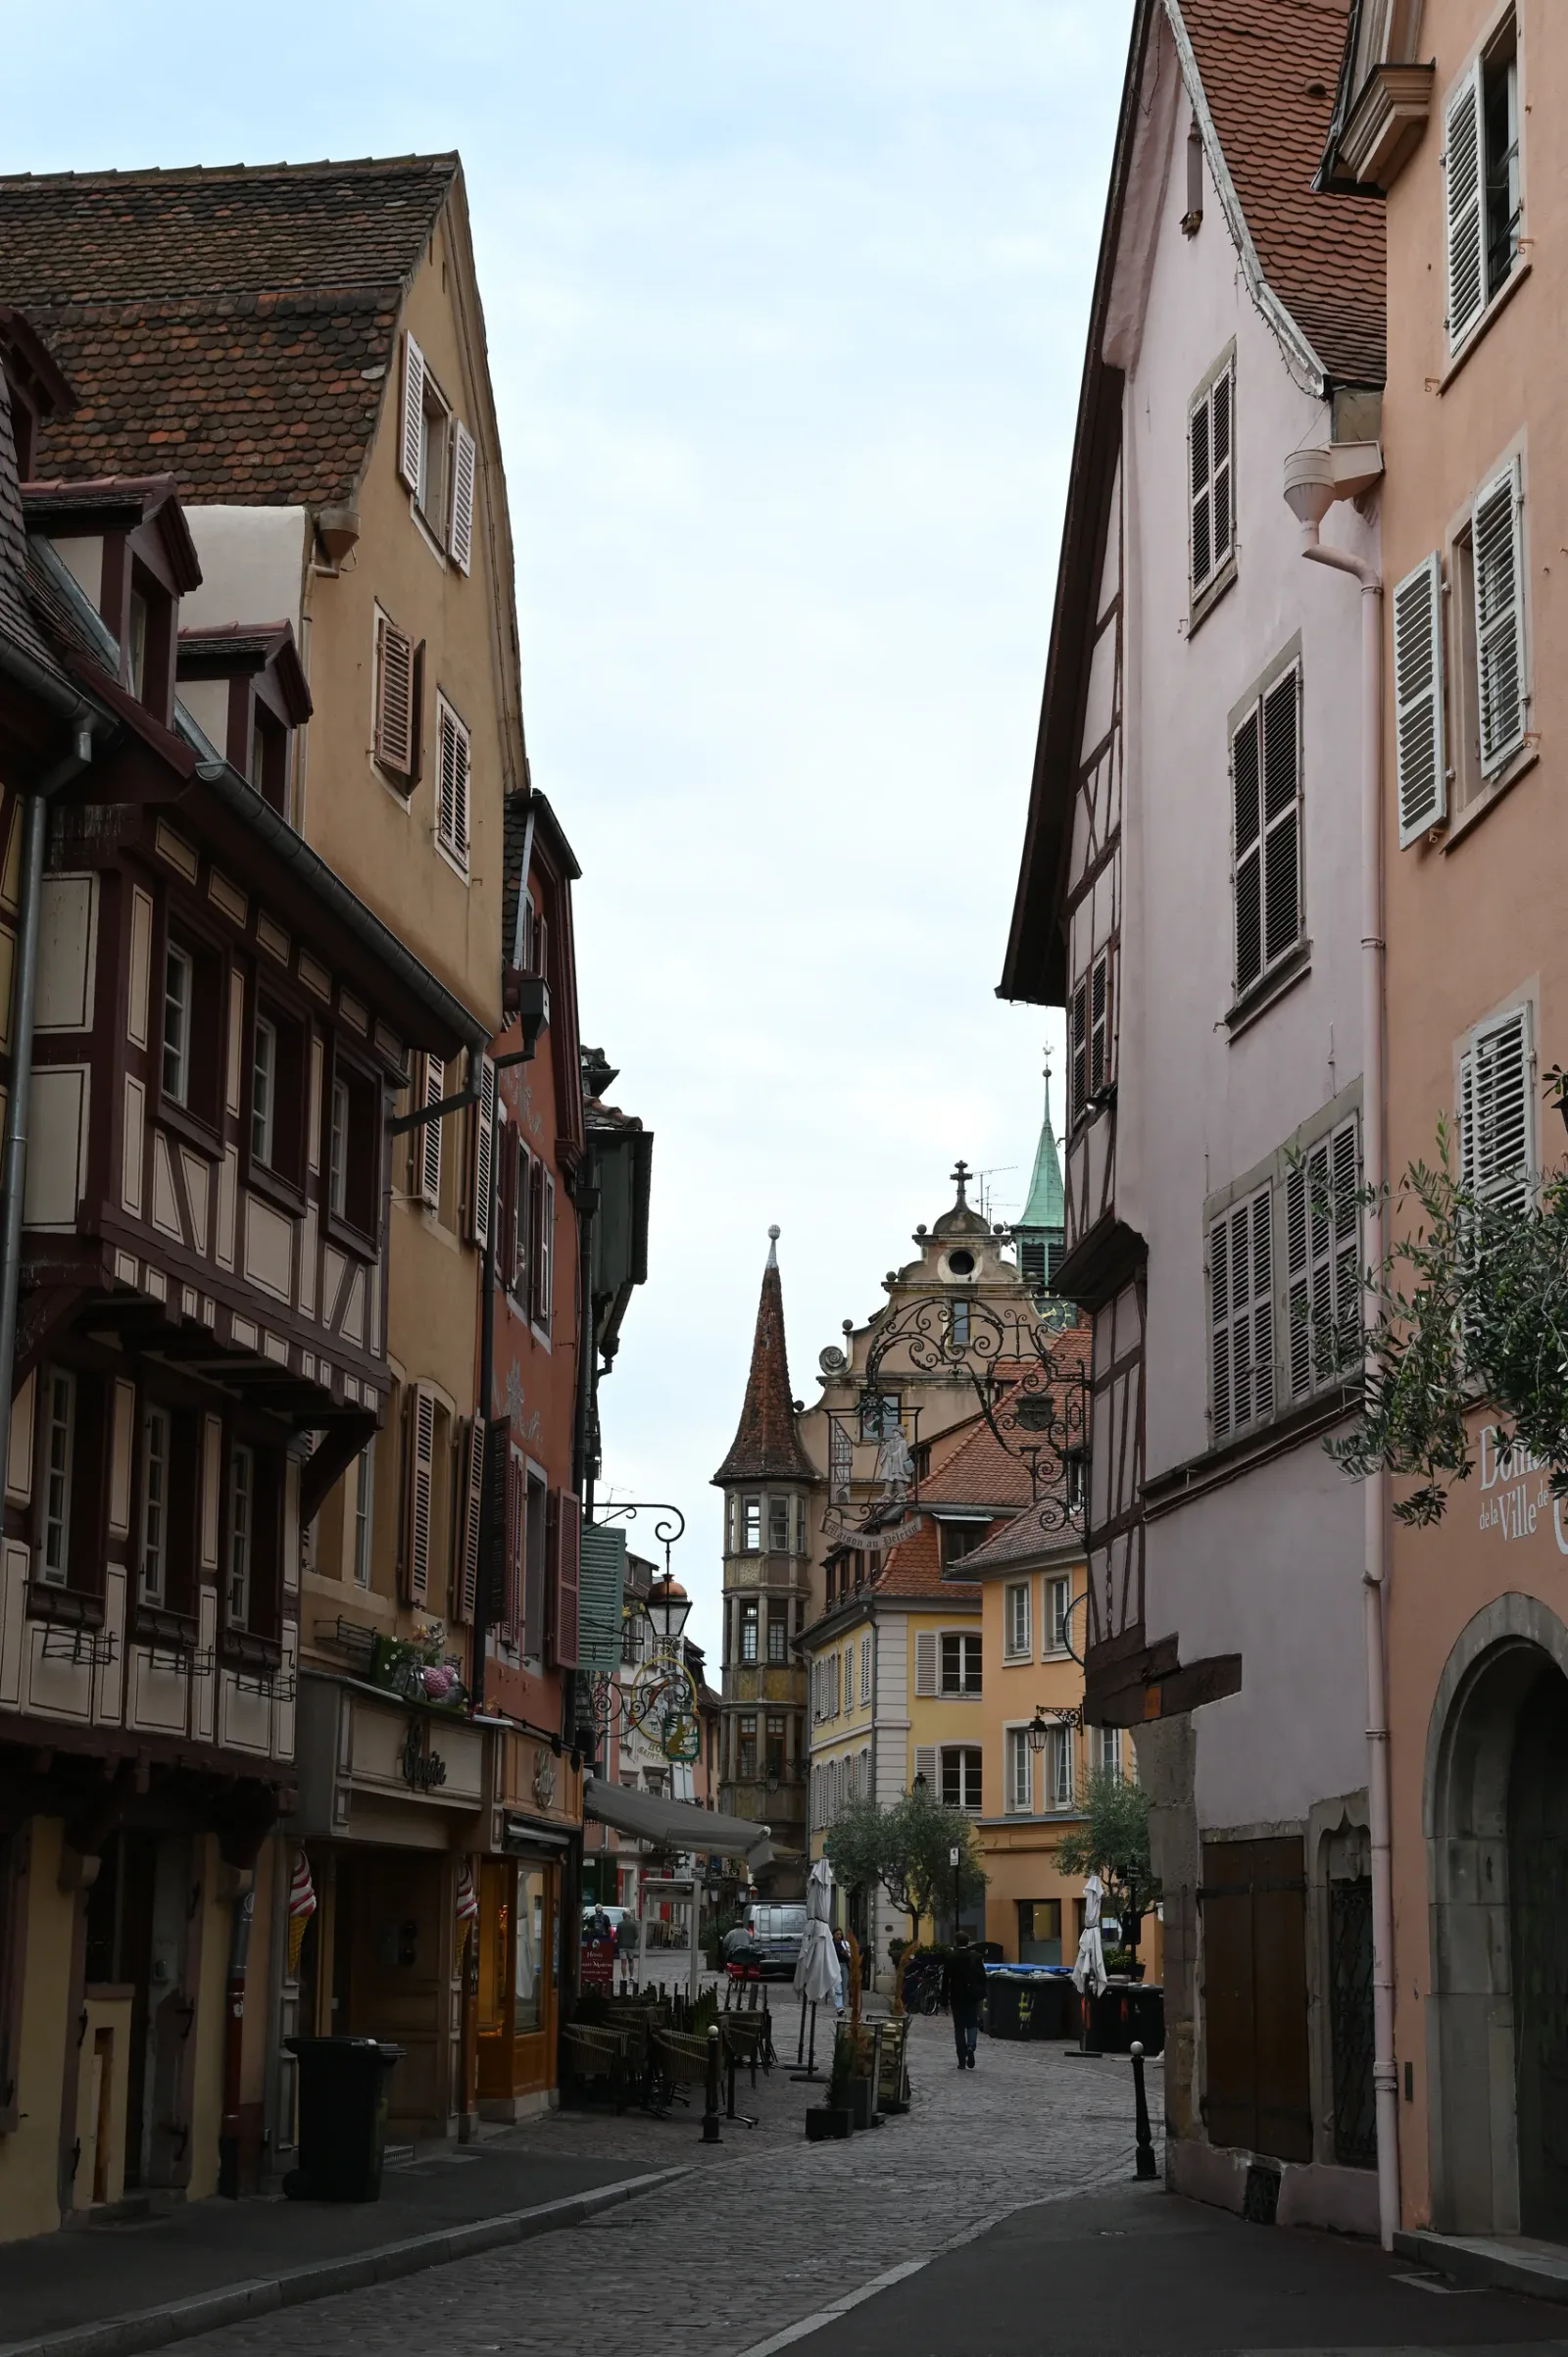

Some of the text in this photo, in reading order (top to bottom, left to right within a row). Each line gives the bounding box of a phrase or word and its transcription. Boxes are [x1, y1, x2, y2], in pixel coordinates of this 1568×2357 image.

[1479, 1502, 1490, 1531] de
[1491, 1498, 1498, 1526] la
[1497, 1484, 1538, 1542] Ville
[1537, 1480, 1548, 1509] de
[827, 1524, 863, 1547] Maison
[866, 1540, 879, 1548] au
